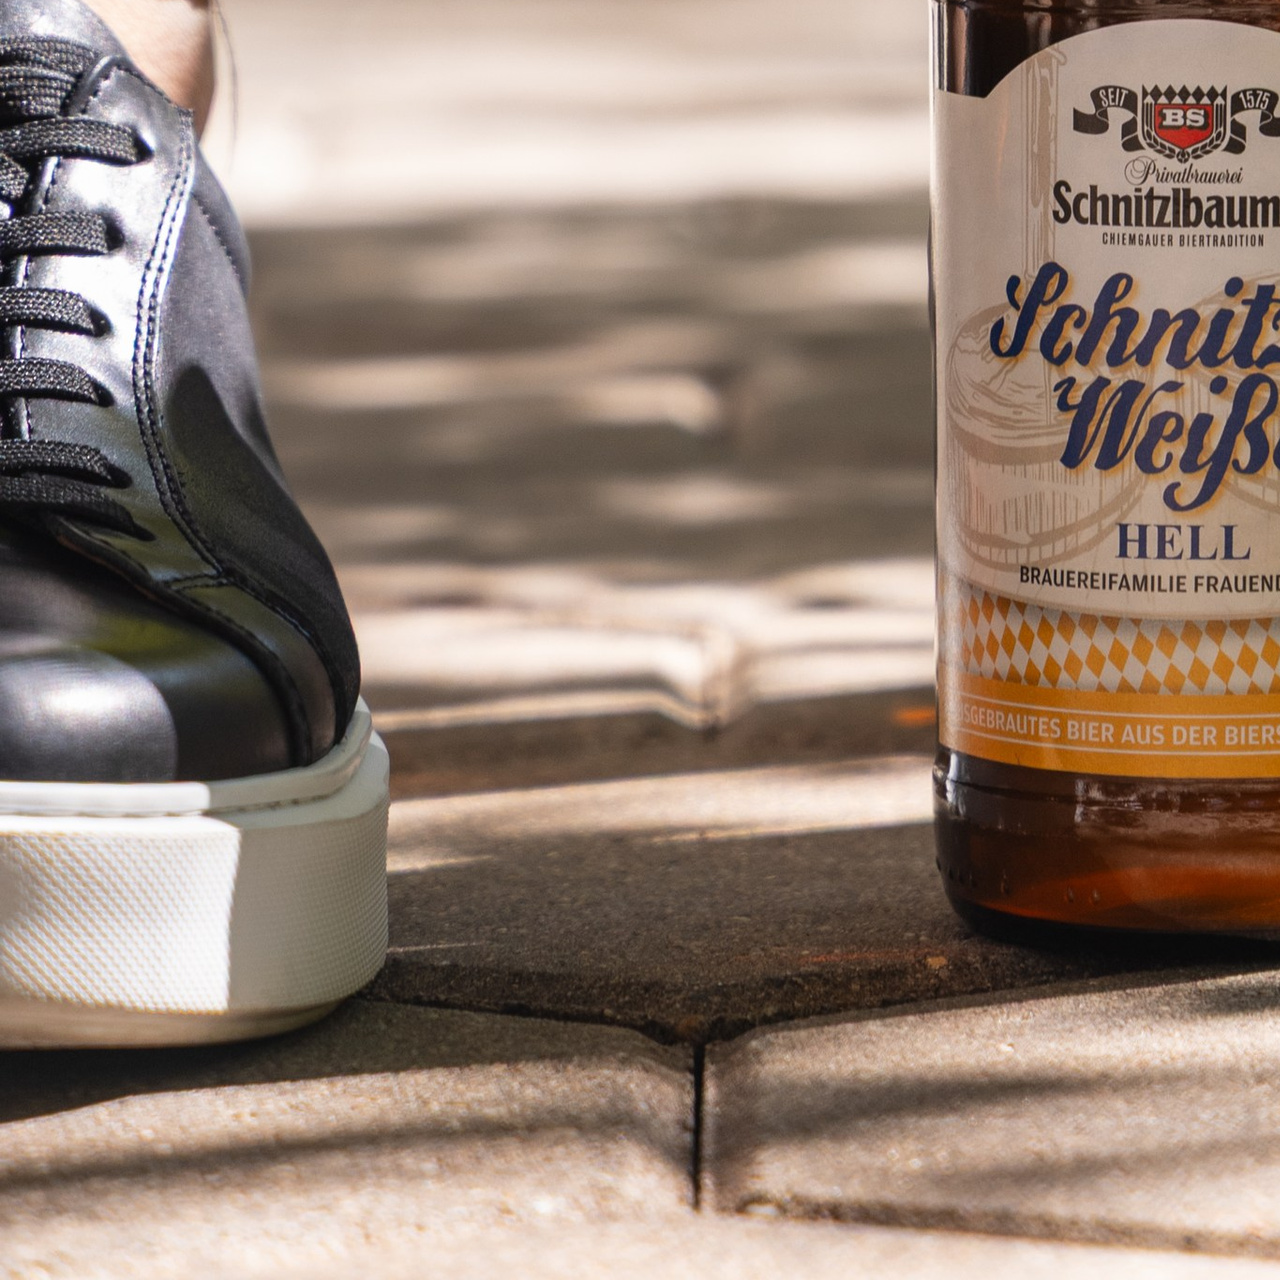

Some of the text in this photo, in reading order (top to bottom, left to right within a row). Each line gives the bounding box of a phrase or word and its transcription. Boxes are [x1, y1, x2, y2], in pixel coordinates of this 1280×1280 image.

[1100, 88, 1128, 108] SEIT
[1238, 90, 1272, 111] 1575
[1162, 107, 1206, 128] BS
[1124, 155, 1244, 186] Privatbrauerei
[1102, 232, 1265, 248] CHIEMGAUER BIERTRADITION
[1115, 522, 1251, 561] HELL
[1019, 565, 1188, 594] BRAUEREIFAMILIE
[1066, 719, 1114, 744] BIER
[1121, 720, 1165, 746] AUS
[1172, 721, 1218, 747] DER
